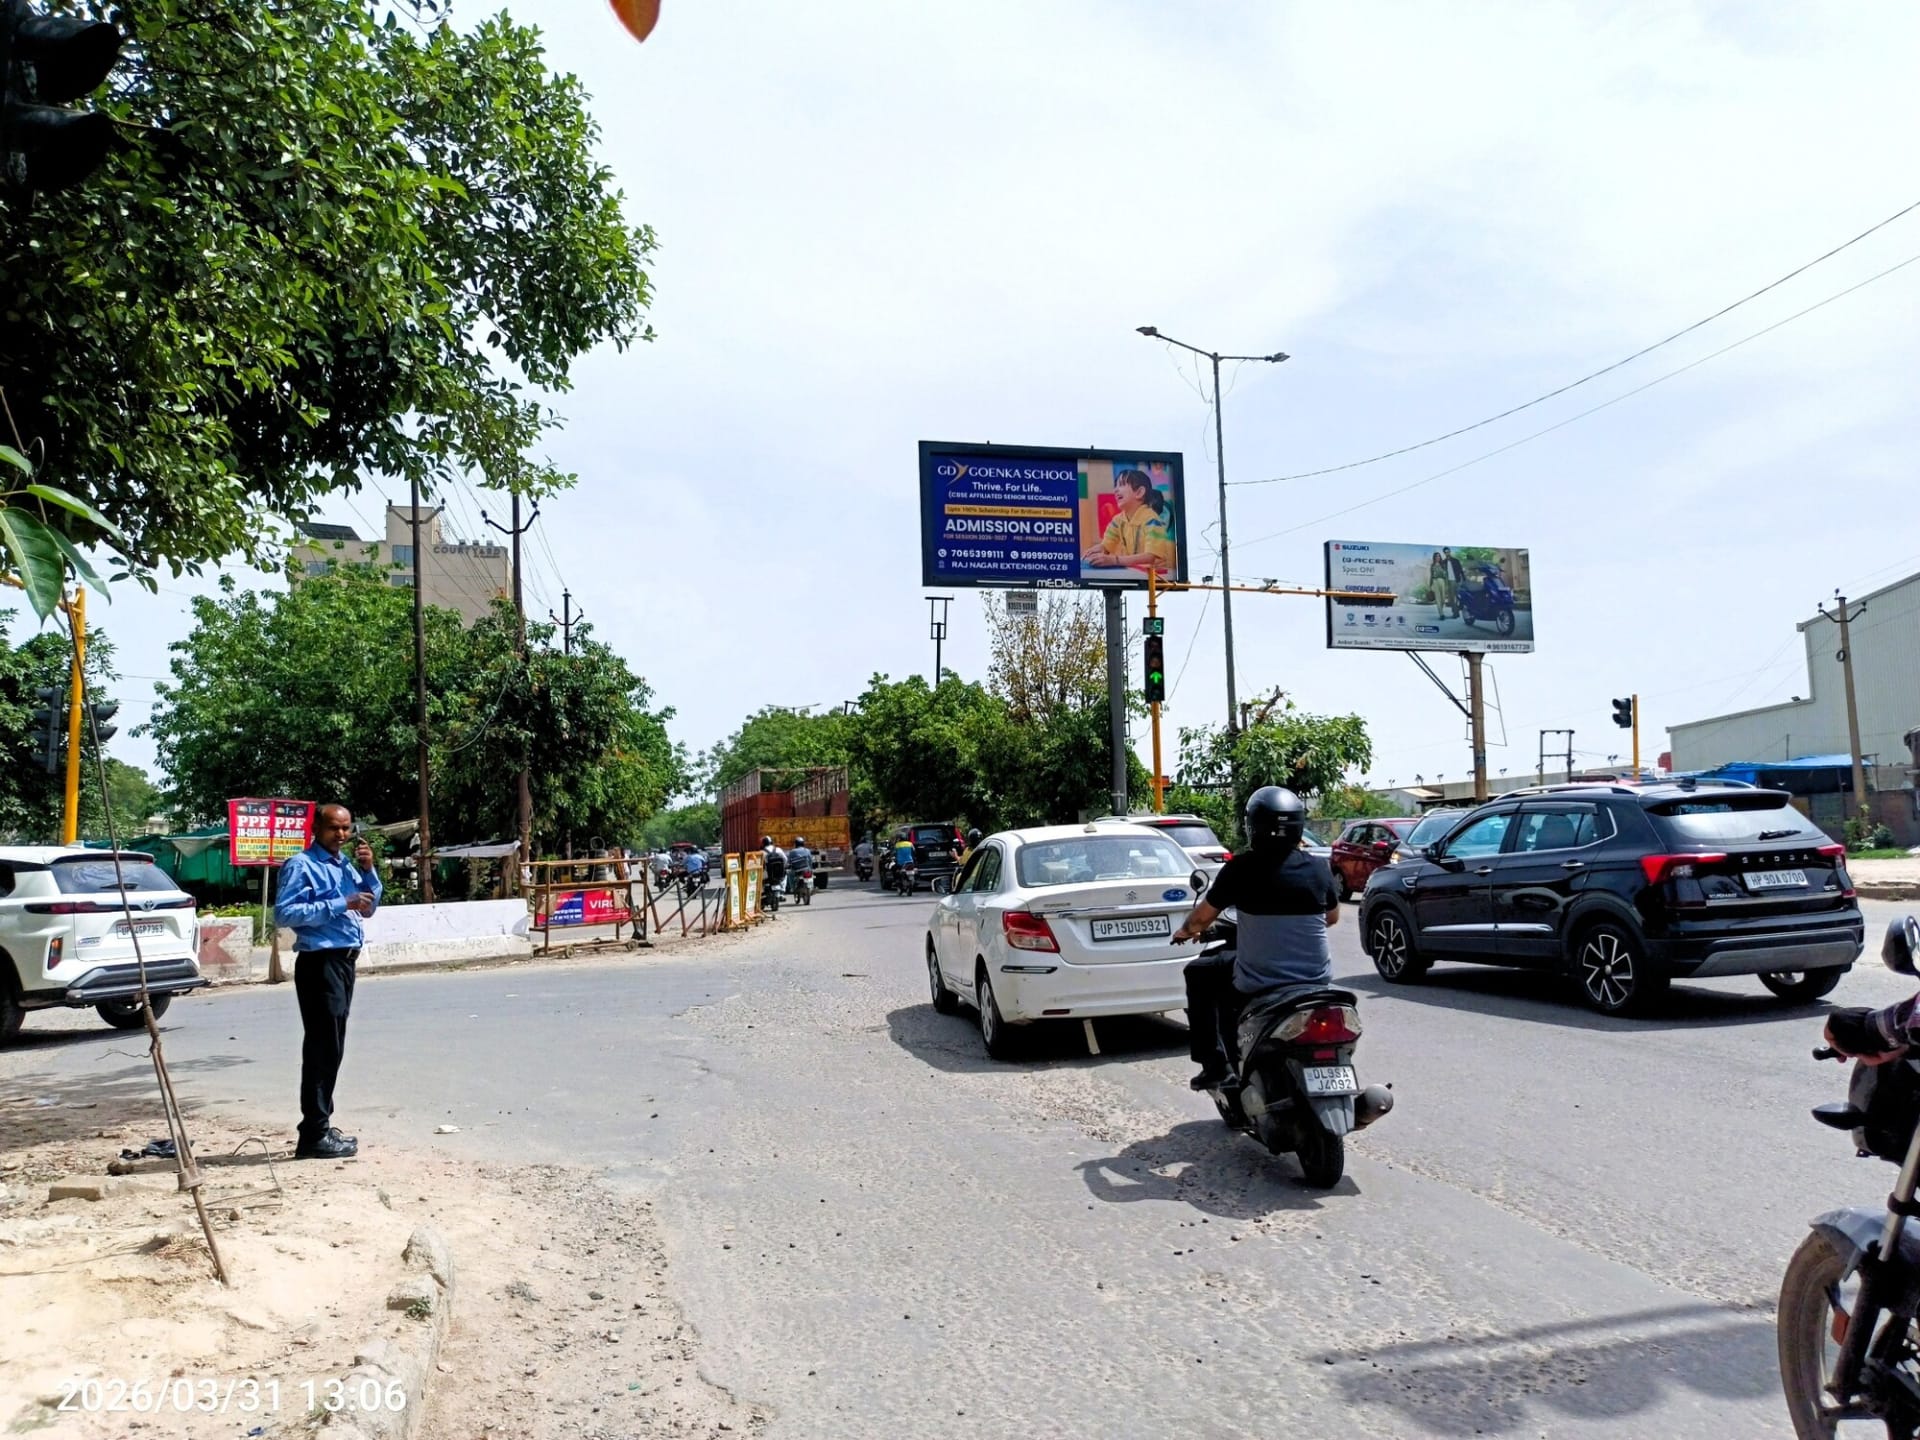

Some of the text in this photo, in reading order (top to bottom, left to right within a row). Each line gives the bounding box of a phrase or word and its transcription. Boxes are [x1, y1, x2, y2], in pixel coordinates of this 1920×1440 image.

[937, 465, 1077, 481] GD GOENKA SCHOOL
[972, 481, 1042, 493] Thrive. For Life.
[1003, 493, 1026, 501] SENIOR
[945, 519, 1073, 535] ADMISSION OPEN
[951, 549, 1004, 559] 7065399111
[951, 561, 969, 569] RAJ
[969, 562, 999, 570] NAGAR
[1049, 563, 1068, 571] GZB
[237, 815, 271, 827] PPF
[274, 817, 306, 829] PPF
[1313, 1068, 1349, 1079] DL9SA
[1318, 1079, 1352, 1090] J4092
